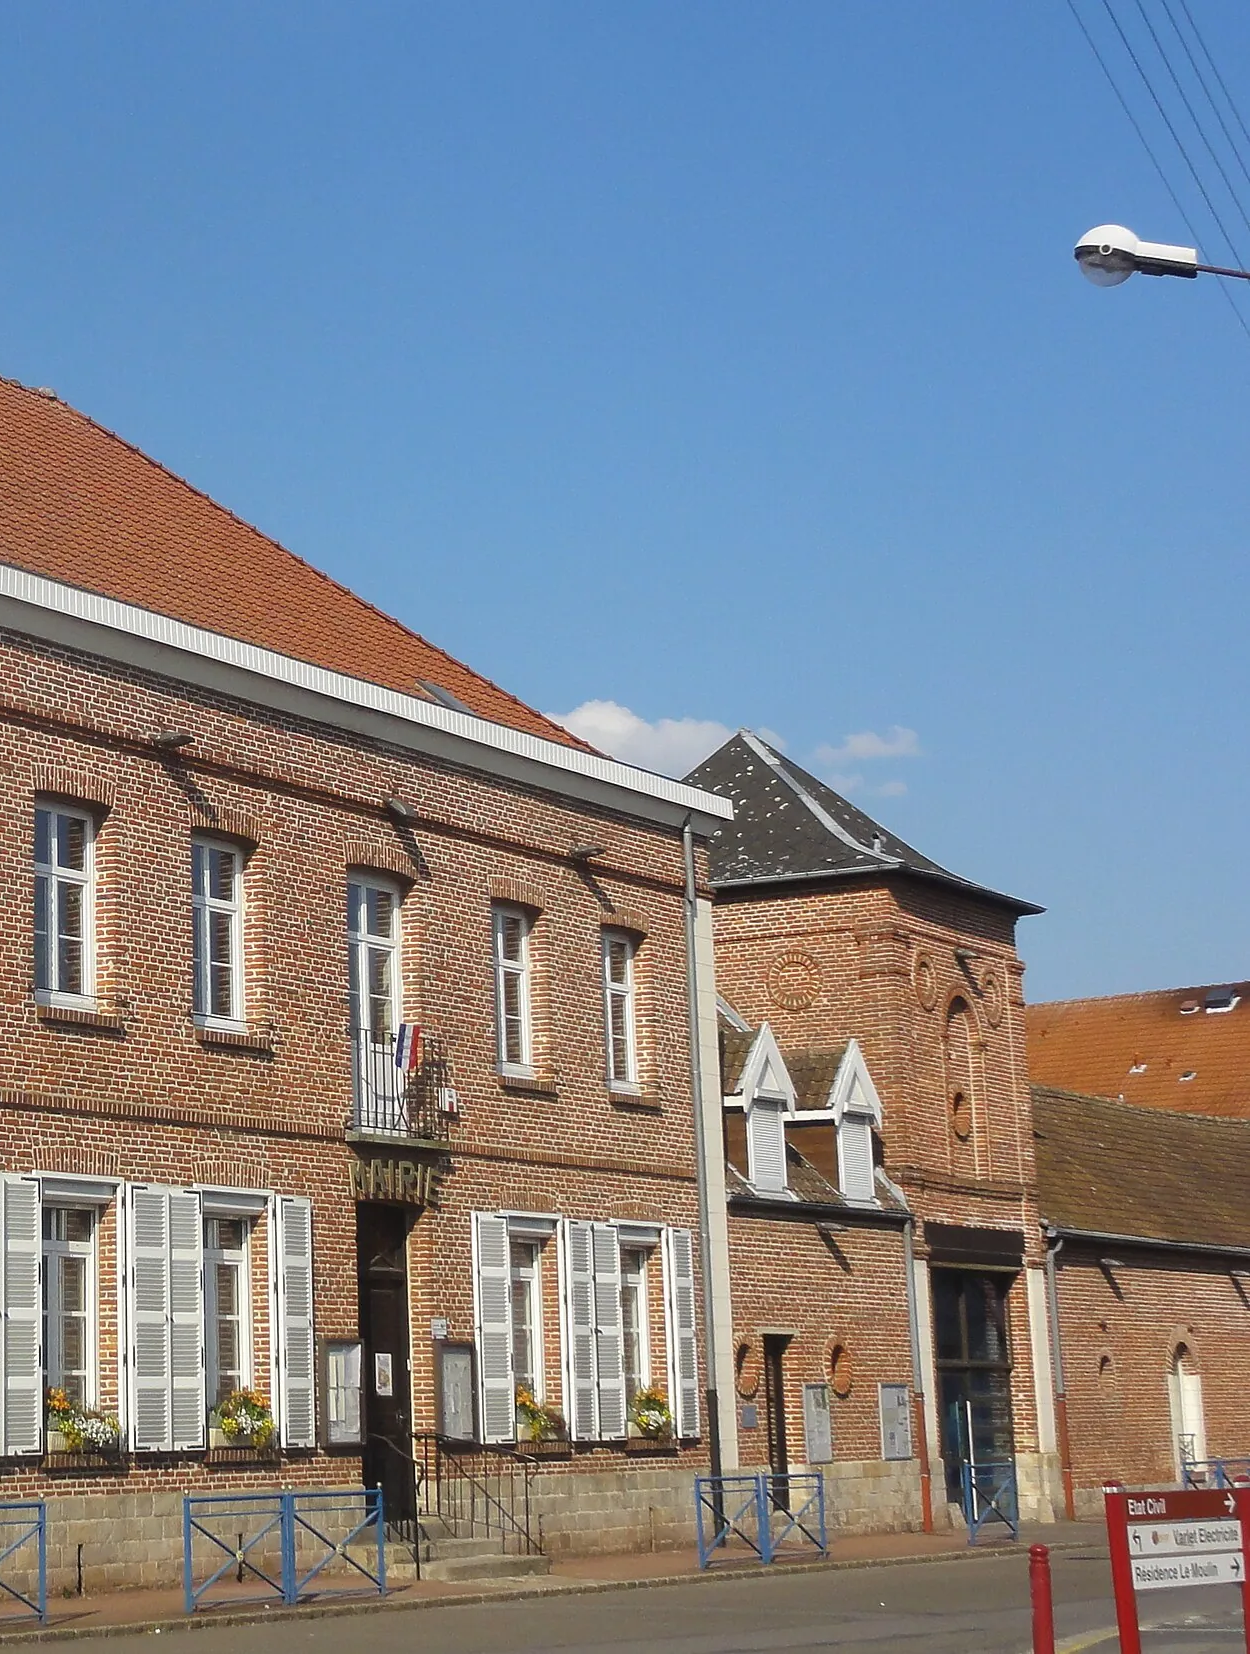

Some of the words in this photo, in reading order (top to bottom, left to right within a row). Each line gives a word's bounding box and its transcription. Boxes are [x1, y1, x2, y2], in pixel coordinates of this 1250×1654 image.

[348, 1159, 443, 1204] MAIRIE
[1127, 1498, 1147, 1516] Etat
[1146, 1498, 1167, 1515] Civil
